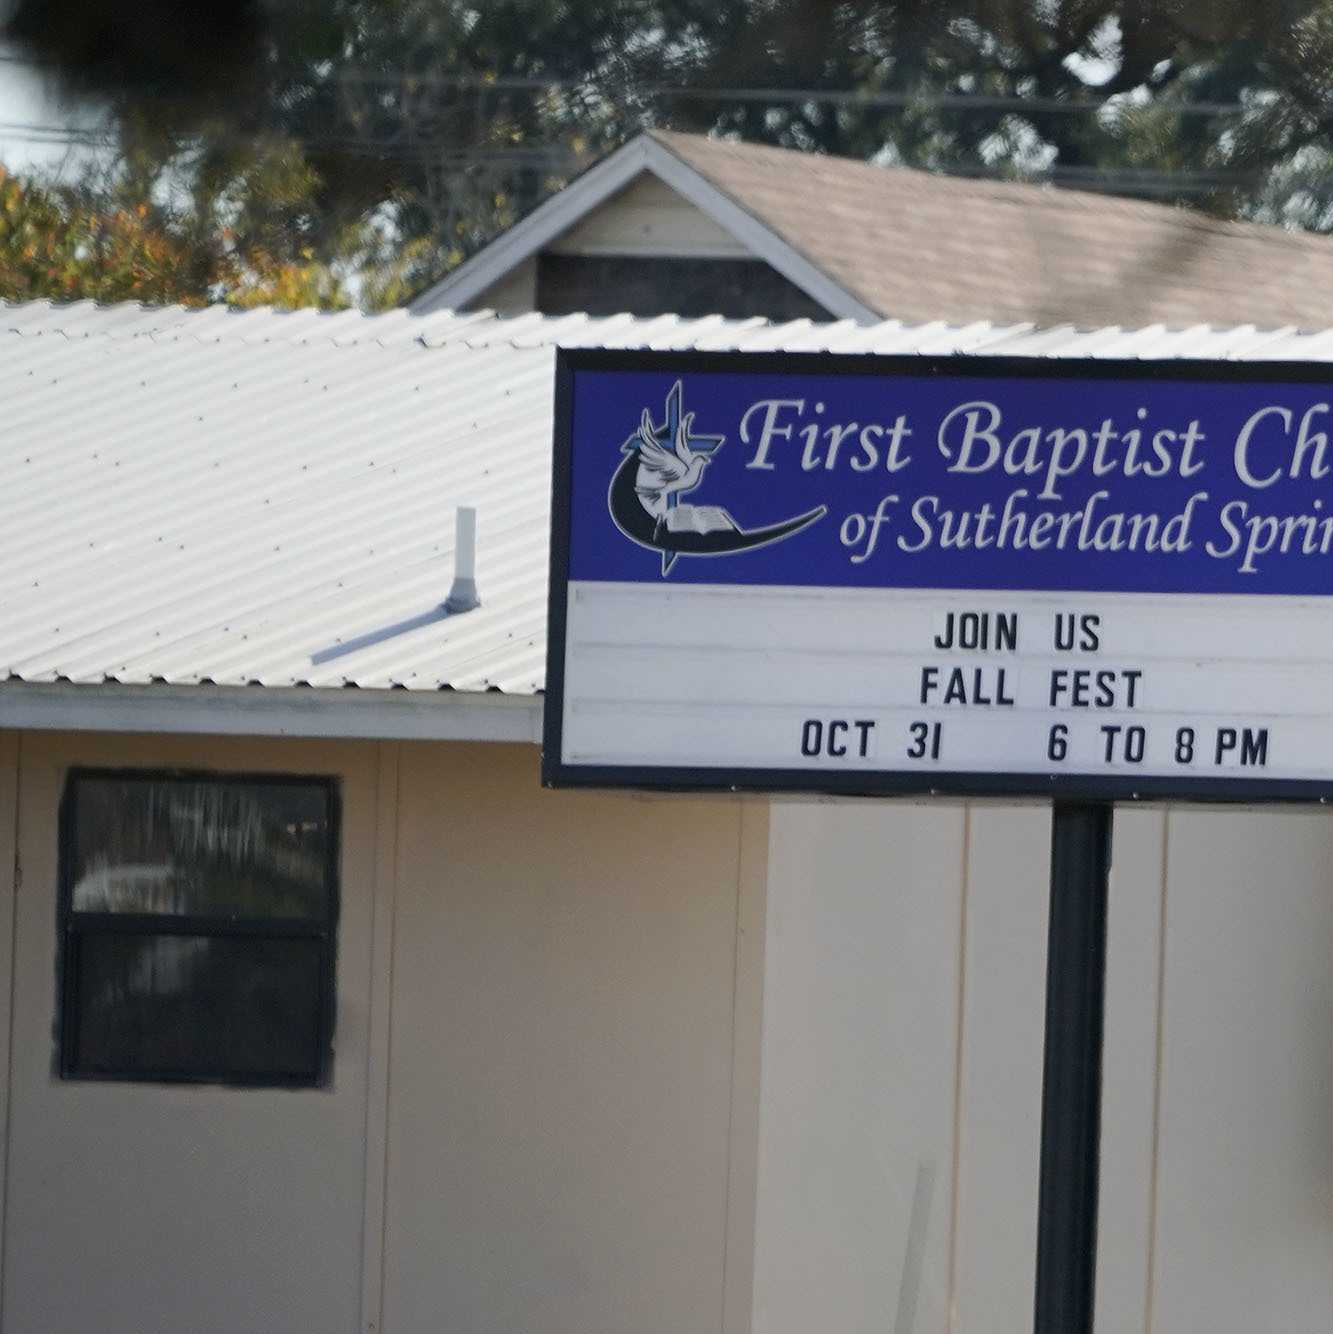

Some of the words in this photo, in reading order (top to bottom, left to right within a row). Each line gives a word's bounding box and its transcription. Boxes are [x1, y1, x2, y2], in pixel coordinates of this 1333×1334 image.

[739, 398, 912, 473] First
[937, 400, 1206, 501] Baptist
[839, 495, 900, 564] of
[896, 488, 1209, 553] Sutherland
[933, 611, 1019, 652] JOIN
[1052, 613, 1102, 653] US
[919, 666, 1015, 707] FALL
[1048, 670, 1143, 709] FEST
[800, 719, 876, 758] OCT
[906, 721, 942, 761] 31
[1046, 723, 1070, 763] 6
[1100, 725, 1147, 764] TO
[1173, 726, 1196, 765] 8
[1214, 728, 1269, 767] PM
